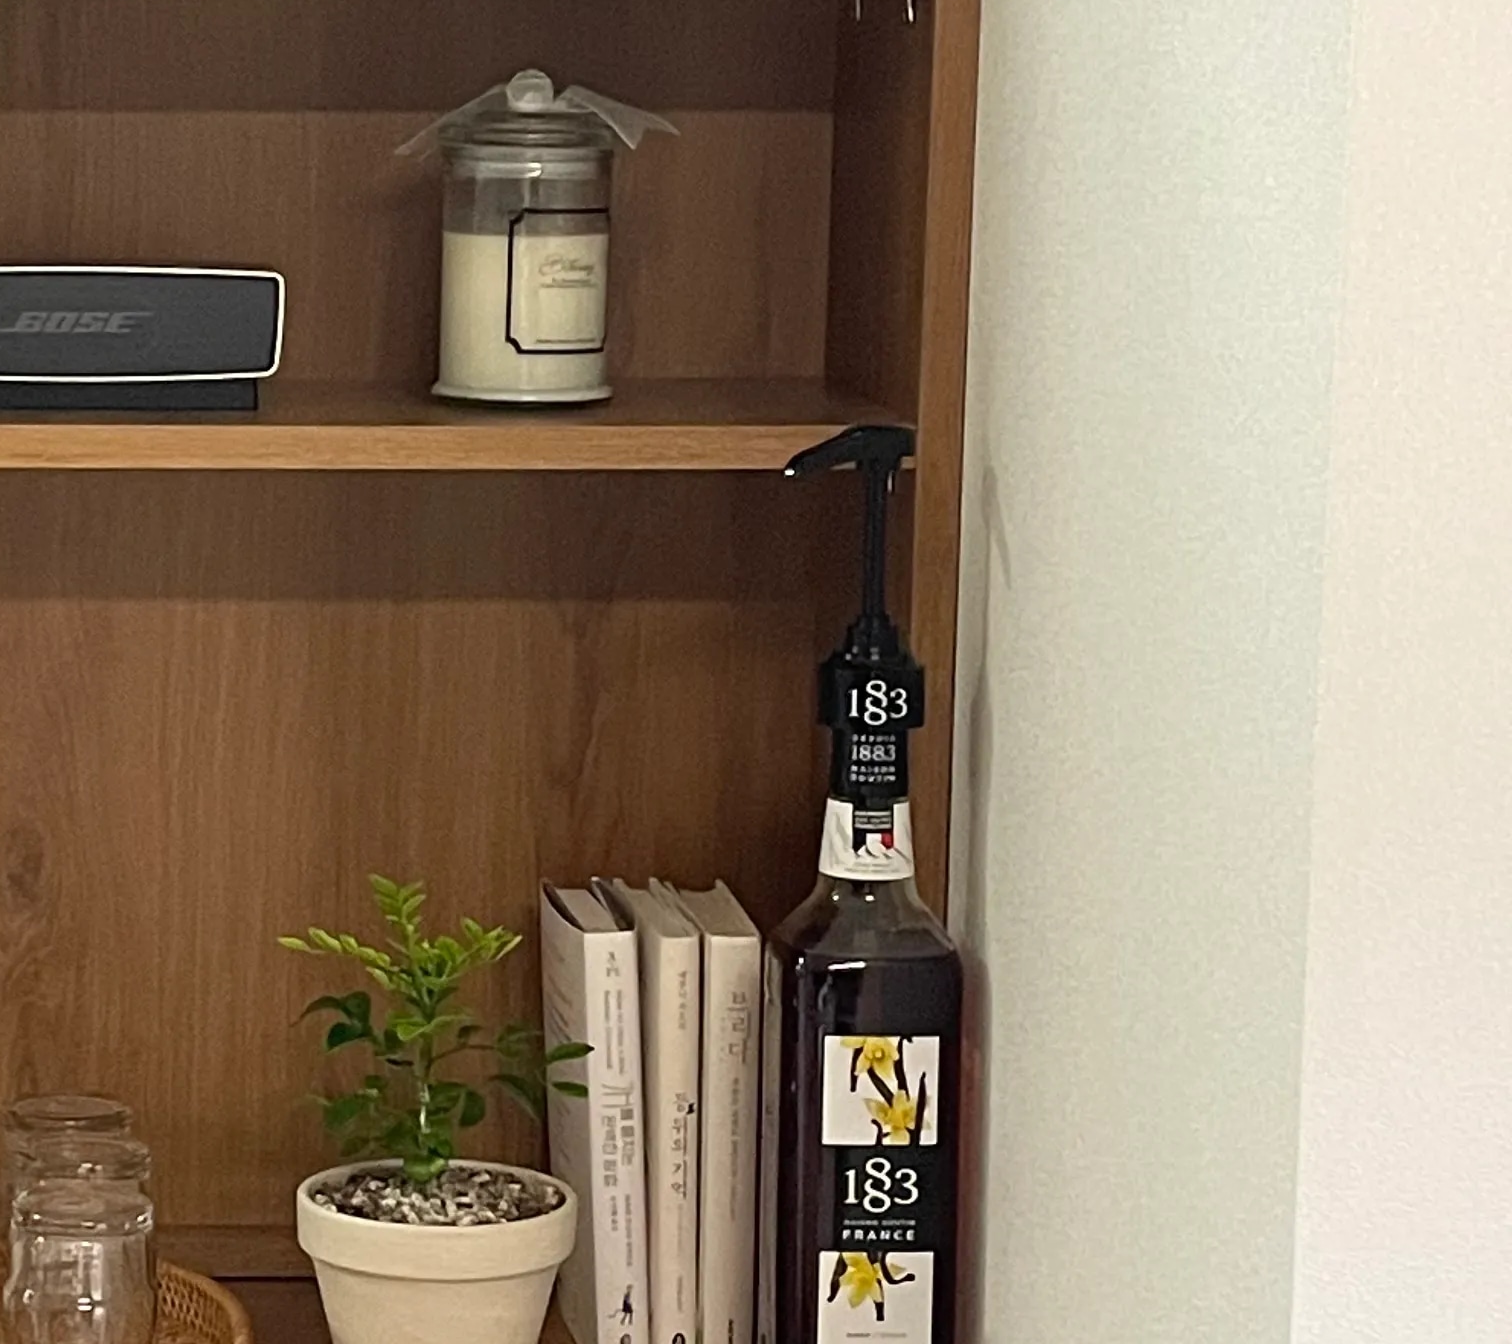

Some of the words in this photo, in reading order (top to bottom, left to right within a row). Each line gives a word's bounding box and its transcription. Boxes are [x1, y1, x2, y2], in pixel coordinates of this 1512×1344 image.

[851, 744, 896, 761] 1883
[843, 1157, 919, 1213] 1883
[842, 1229, 916, 1241] FRANCE
